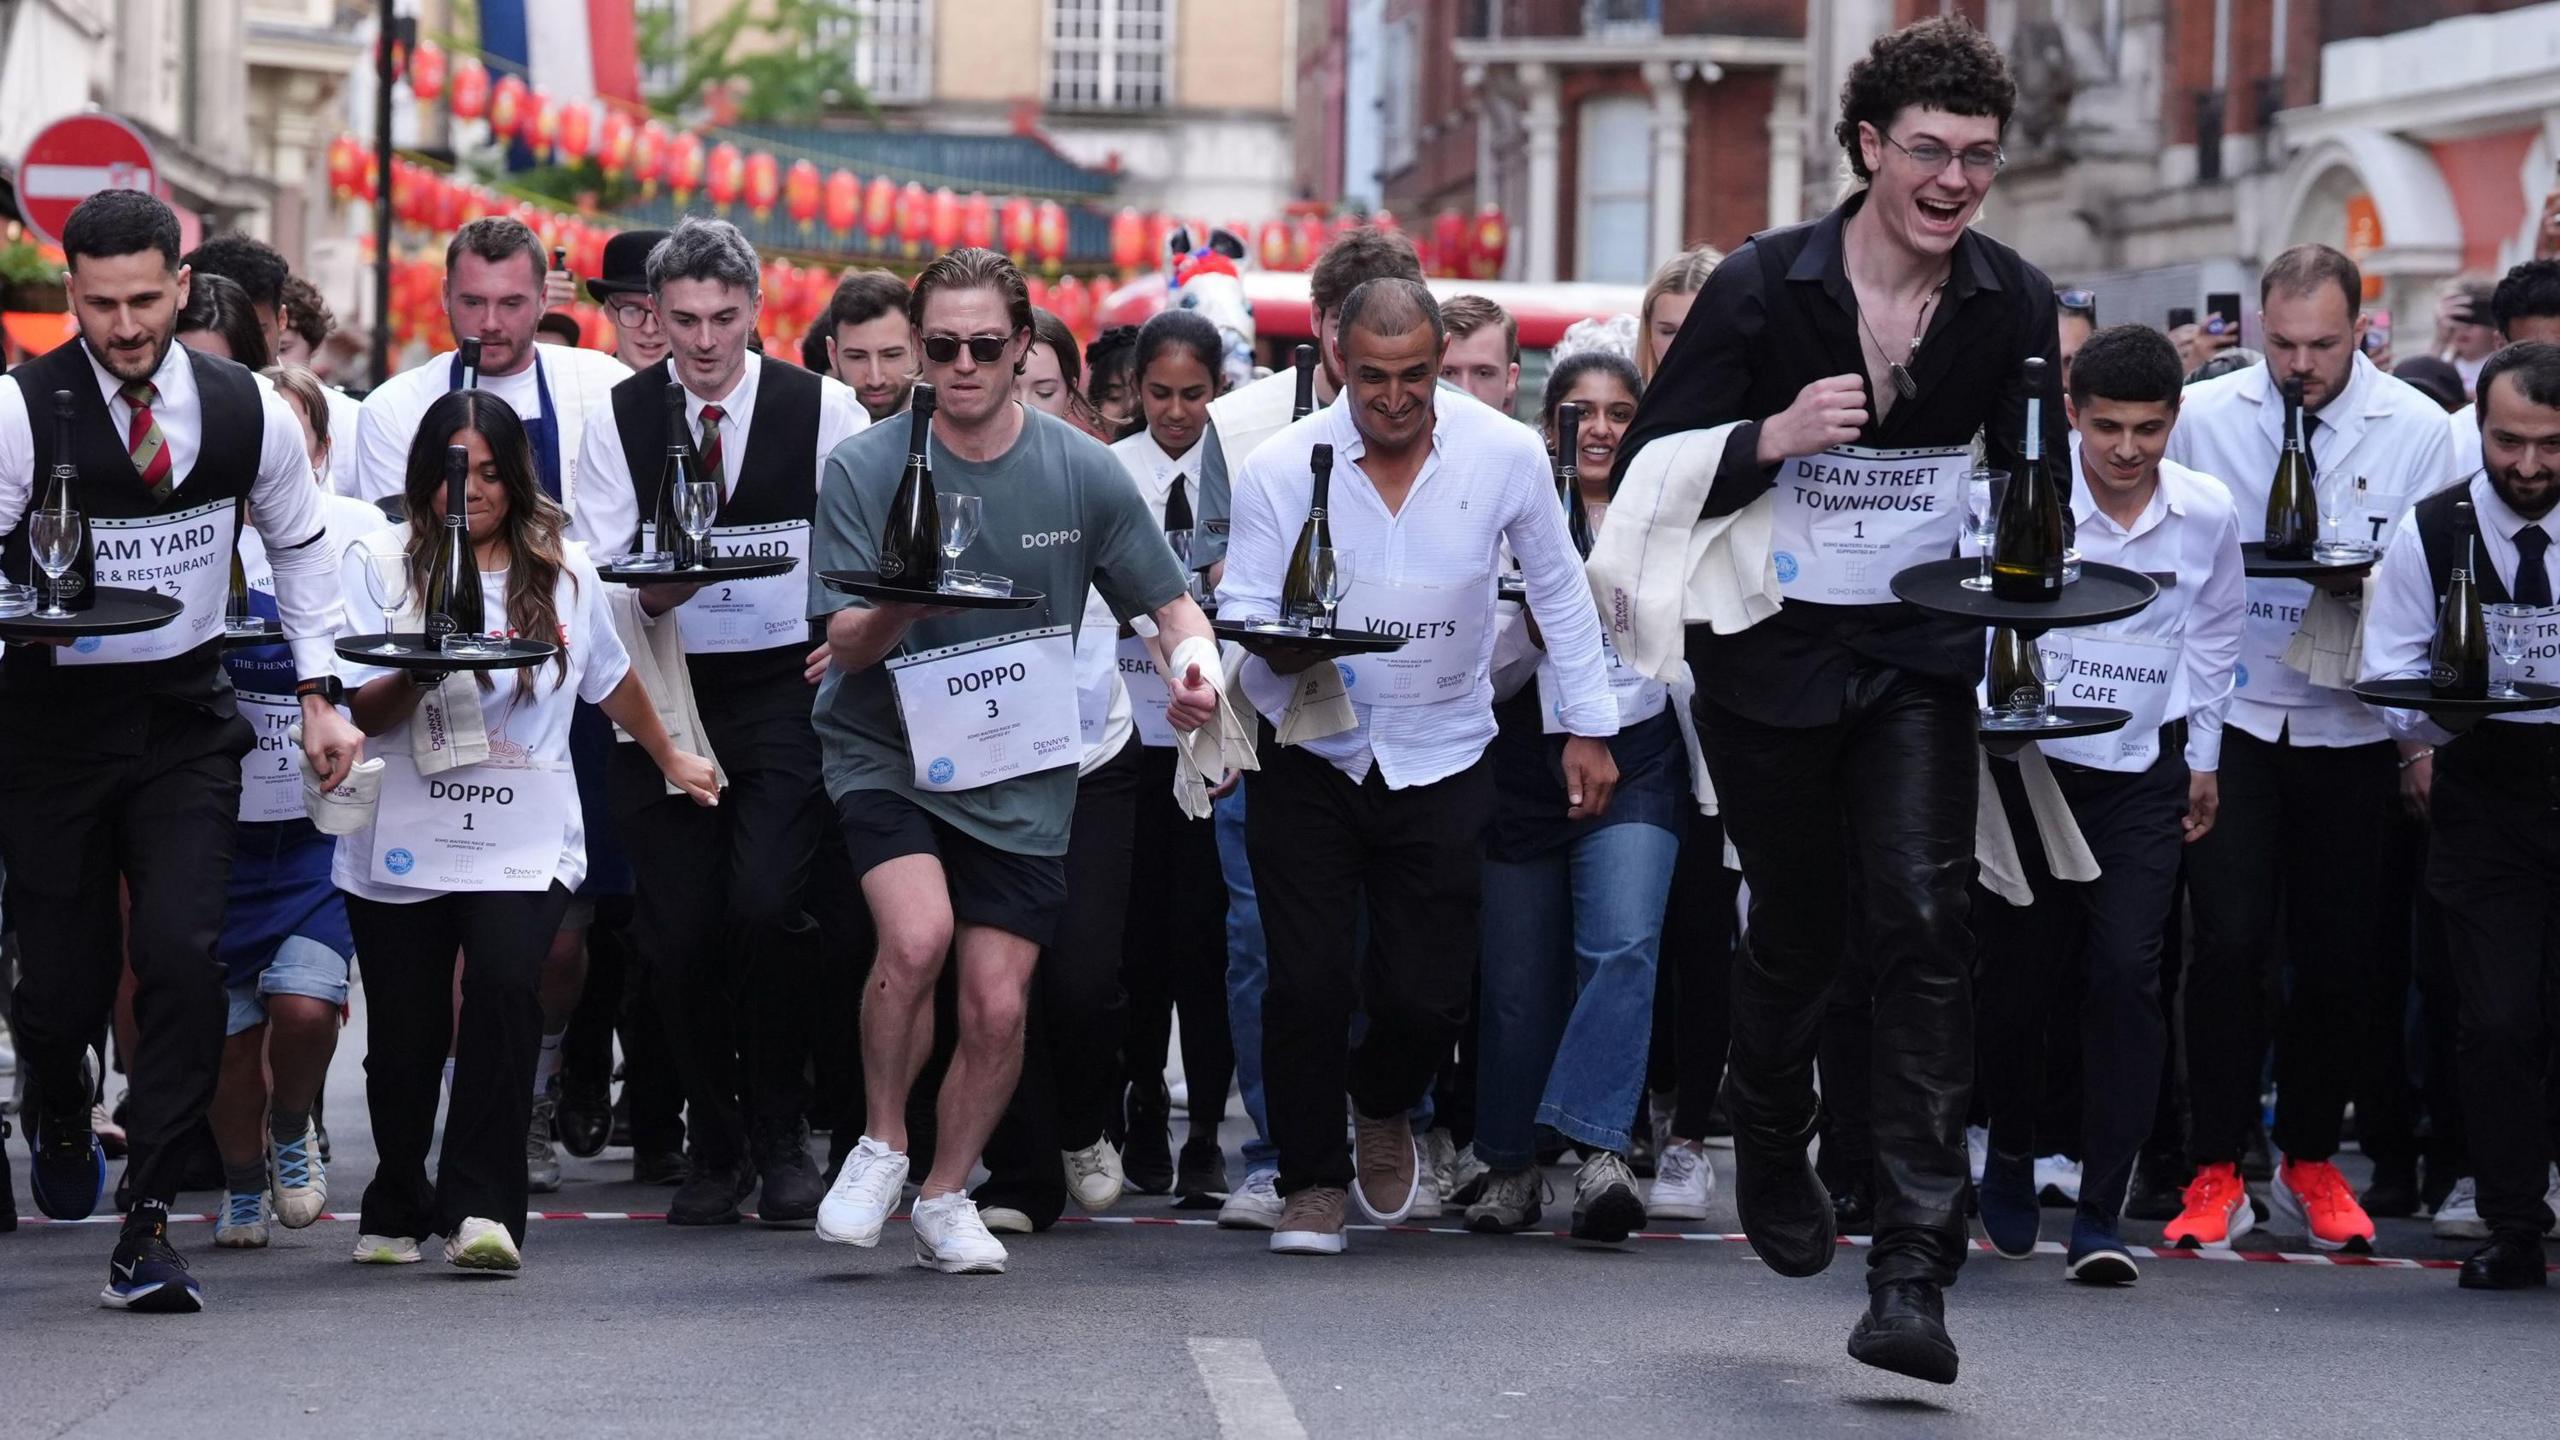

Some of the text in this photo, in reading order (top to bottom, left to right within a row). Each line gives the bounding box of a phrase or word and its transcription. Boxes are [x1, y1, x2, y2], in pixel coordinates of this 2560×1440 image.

[1797, 460, 1939, 486] DEAN STREET
[1793, 486, 1936, 512] TOWNHOUSE
[1021, 529, 1081, 549] DOPPO
[1853, 520, 1865, 539] 1
[95, 524, 215, 560] AM YARD
[727, 540, 789, 557] YARD
[110, 569, 122, 582] &
[127, 552, 216, 581] RESTAURANT
[721, 587, 732, 601] 2
[1614, 587, 1623, 633] DENNYS
[2246, 602, 2272, 619] AR
[764, 618, 798, 630] DENNYS
[1365, 616, 1456, 639] VIOLET'S
[233, 658, 255, 670] THE
[1612, 654, 1623, 668] 1
[947, 662, 1026, 697] DOPPO
[2524, 665, 2536, 678] 2
[2072, 683, 2118, 703] CAFE
[985, 699, 999, 719] 3
[425, 704, 441, 752] DENNYS
[1033, 735, 1070, 751] DENNYS
[1037, 744, 1067, 756] BRANDS
[277, 757, 289, 772] 2
[430, 780, 514, 805] DOPPO
[463, 812, 475, 831] 1
[503, 866, 543, 875] DENNYS
